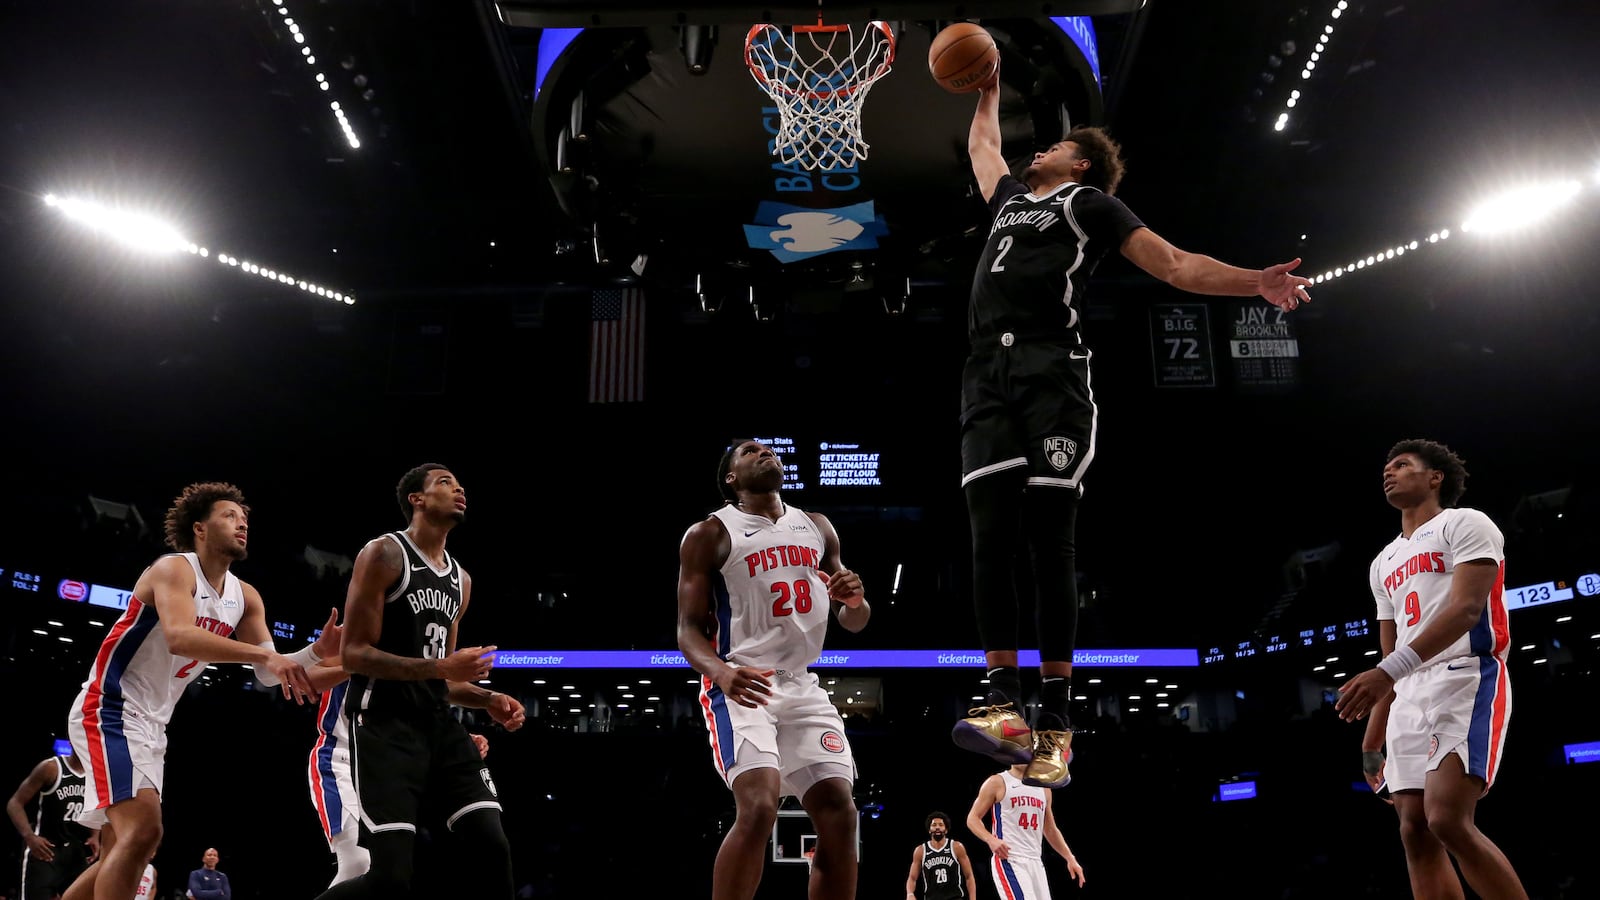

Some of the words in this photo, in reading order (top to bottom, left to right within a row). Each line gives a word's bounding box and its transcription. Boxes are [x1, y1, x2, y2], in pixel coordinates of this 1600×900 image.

[951, 61, 992, 88] Wilson
[994, 210, 1060, 232] ROOKLYN
[990, 235, 1014, 273] 2
[1164, 319, 1197, 331] B.I.G.
[1235, 307, 1268, 325] JAY
[1235, 325, 1288, 336] BROOKLYN
[1164, 338, 1200, 359] 72
[1238, 342, 1250, 356] 8
[1046, 439, 1074, 455] NETS
[744, 545, 818, 578] PISTONS
[1384, 552, 1446, 598] PISTONS
[770, 579, 812, 618] 28
[1517, 586, 1551, 604] 123
[1404, 590, 1421, 627] 9
[1323, 625, 1336, 633] AST
[423, 622, 447, 660] 33
[499, 653, 564, 665] ticketmaster
[1073, 653, 1139, 664] ticketmaster
[56, 785, 85, 800] BROOK
[63, 802, 83, 822] 28
[1018, 813, 1038, 830] 44
[924, 856, 954, 869] BROOKLYN
[935, 868, 948, 883] 26
